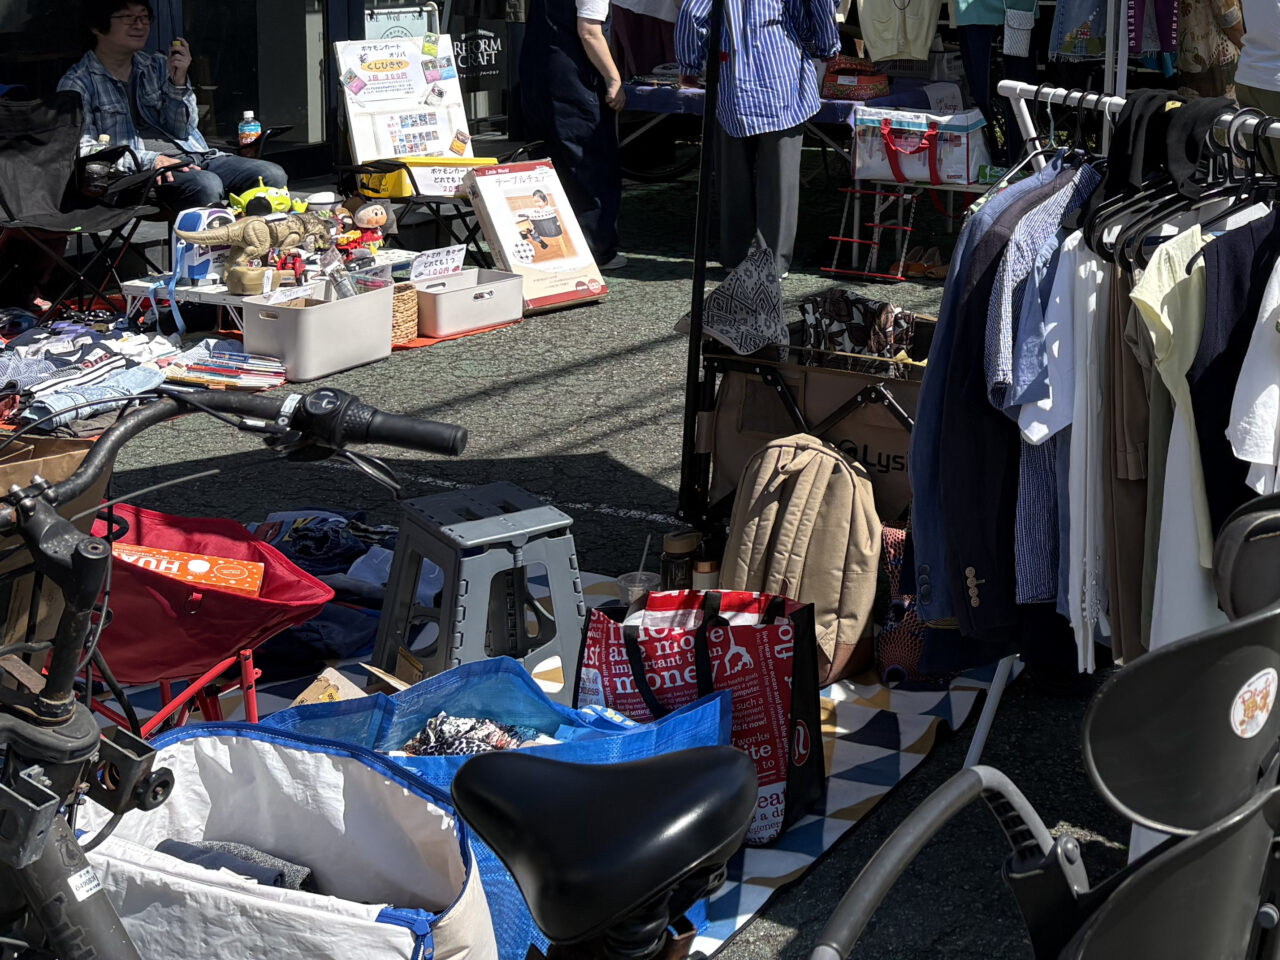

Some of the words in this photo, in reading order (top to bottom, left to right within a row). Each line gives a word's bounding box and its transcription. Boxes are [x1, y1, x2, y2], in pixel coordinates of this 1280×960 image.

[367, 61, 404, 71] くじびきや
[458, 50, 498, 68] CRAFT
[655, 627, 724, 656] moe
[611, 655, 683, 676] imprtant
